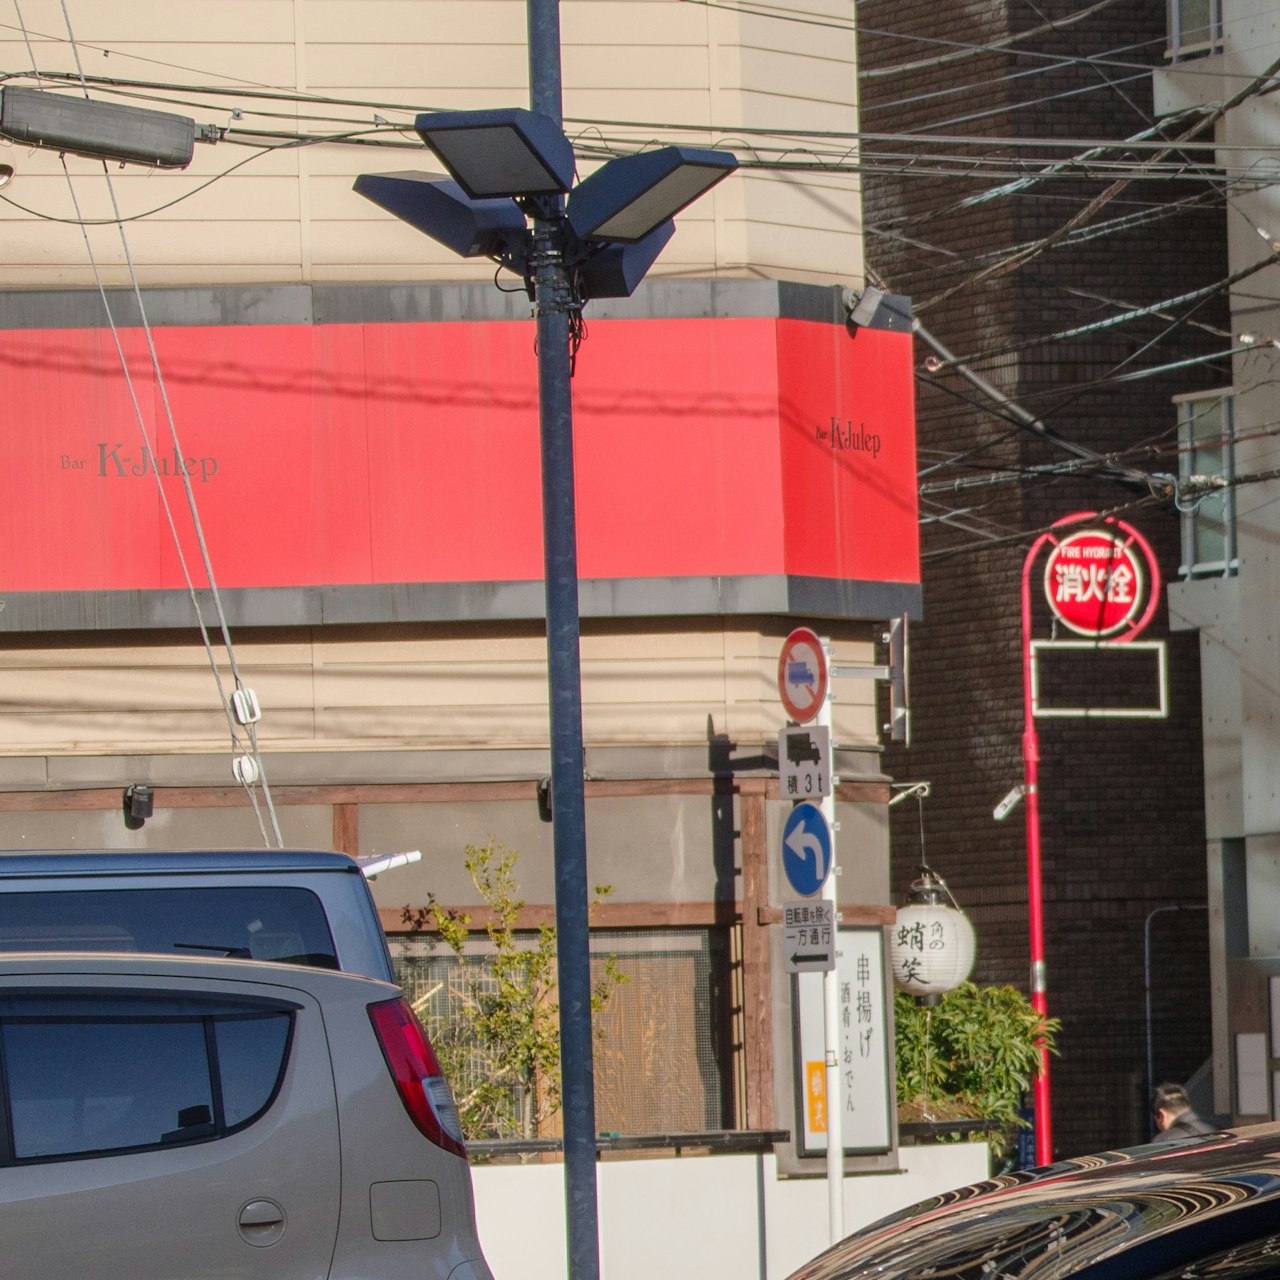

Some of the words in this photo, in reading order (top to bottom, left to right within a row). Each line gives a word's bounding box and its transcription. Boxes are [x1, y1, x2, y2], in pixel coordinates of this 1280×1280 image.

[830, 416, 881, 459] K-Julep
[61, 455, 87, 469] Bar
[97, 443, 219, 482] K-Julep
[1061, 546, 1080, 559] FIRE
[1082, 546, 1123, 559] HYDRANT
[1055, 564, 1132, 603] 消火栓
[785, 905, 831, 925] 自転車を除く
[786, 928, 831, 946] 一方通行
[856, 953, 873, 1058] 串揚げ
